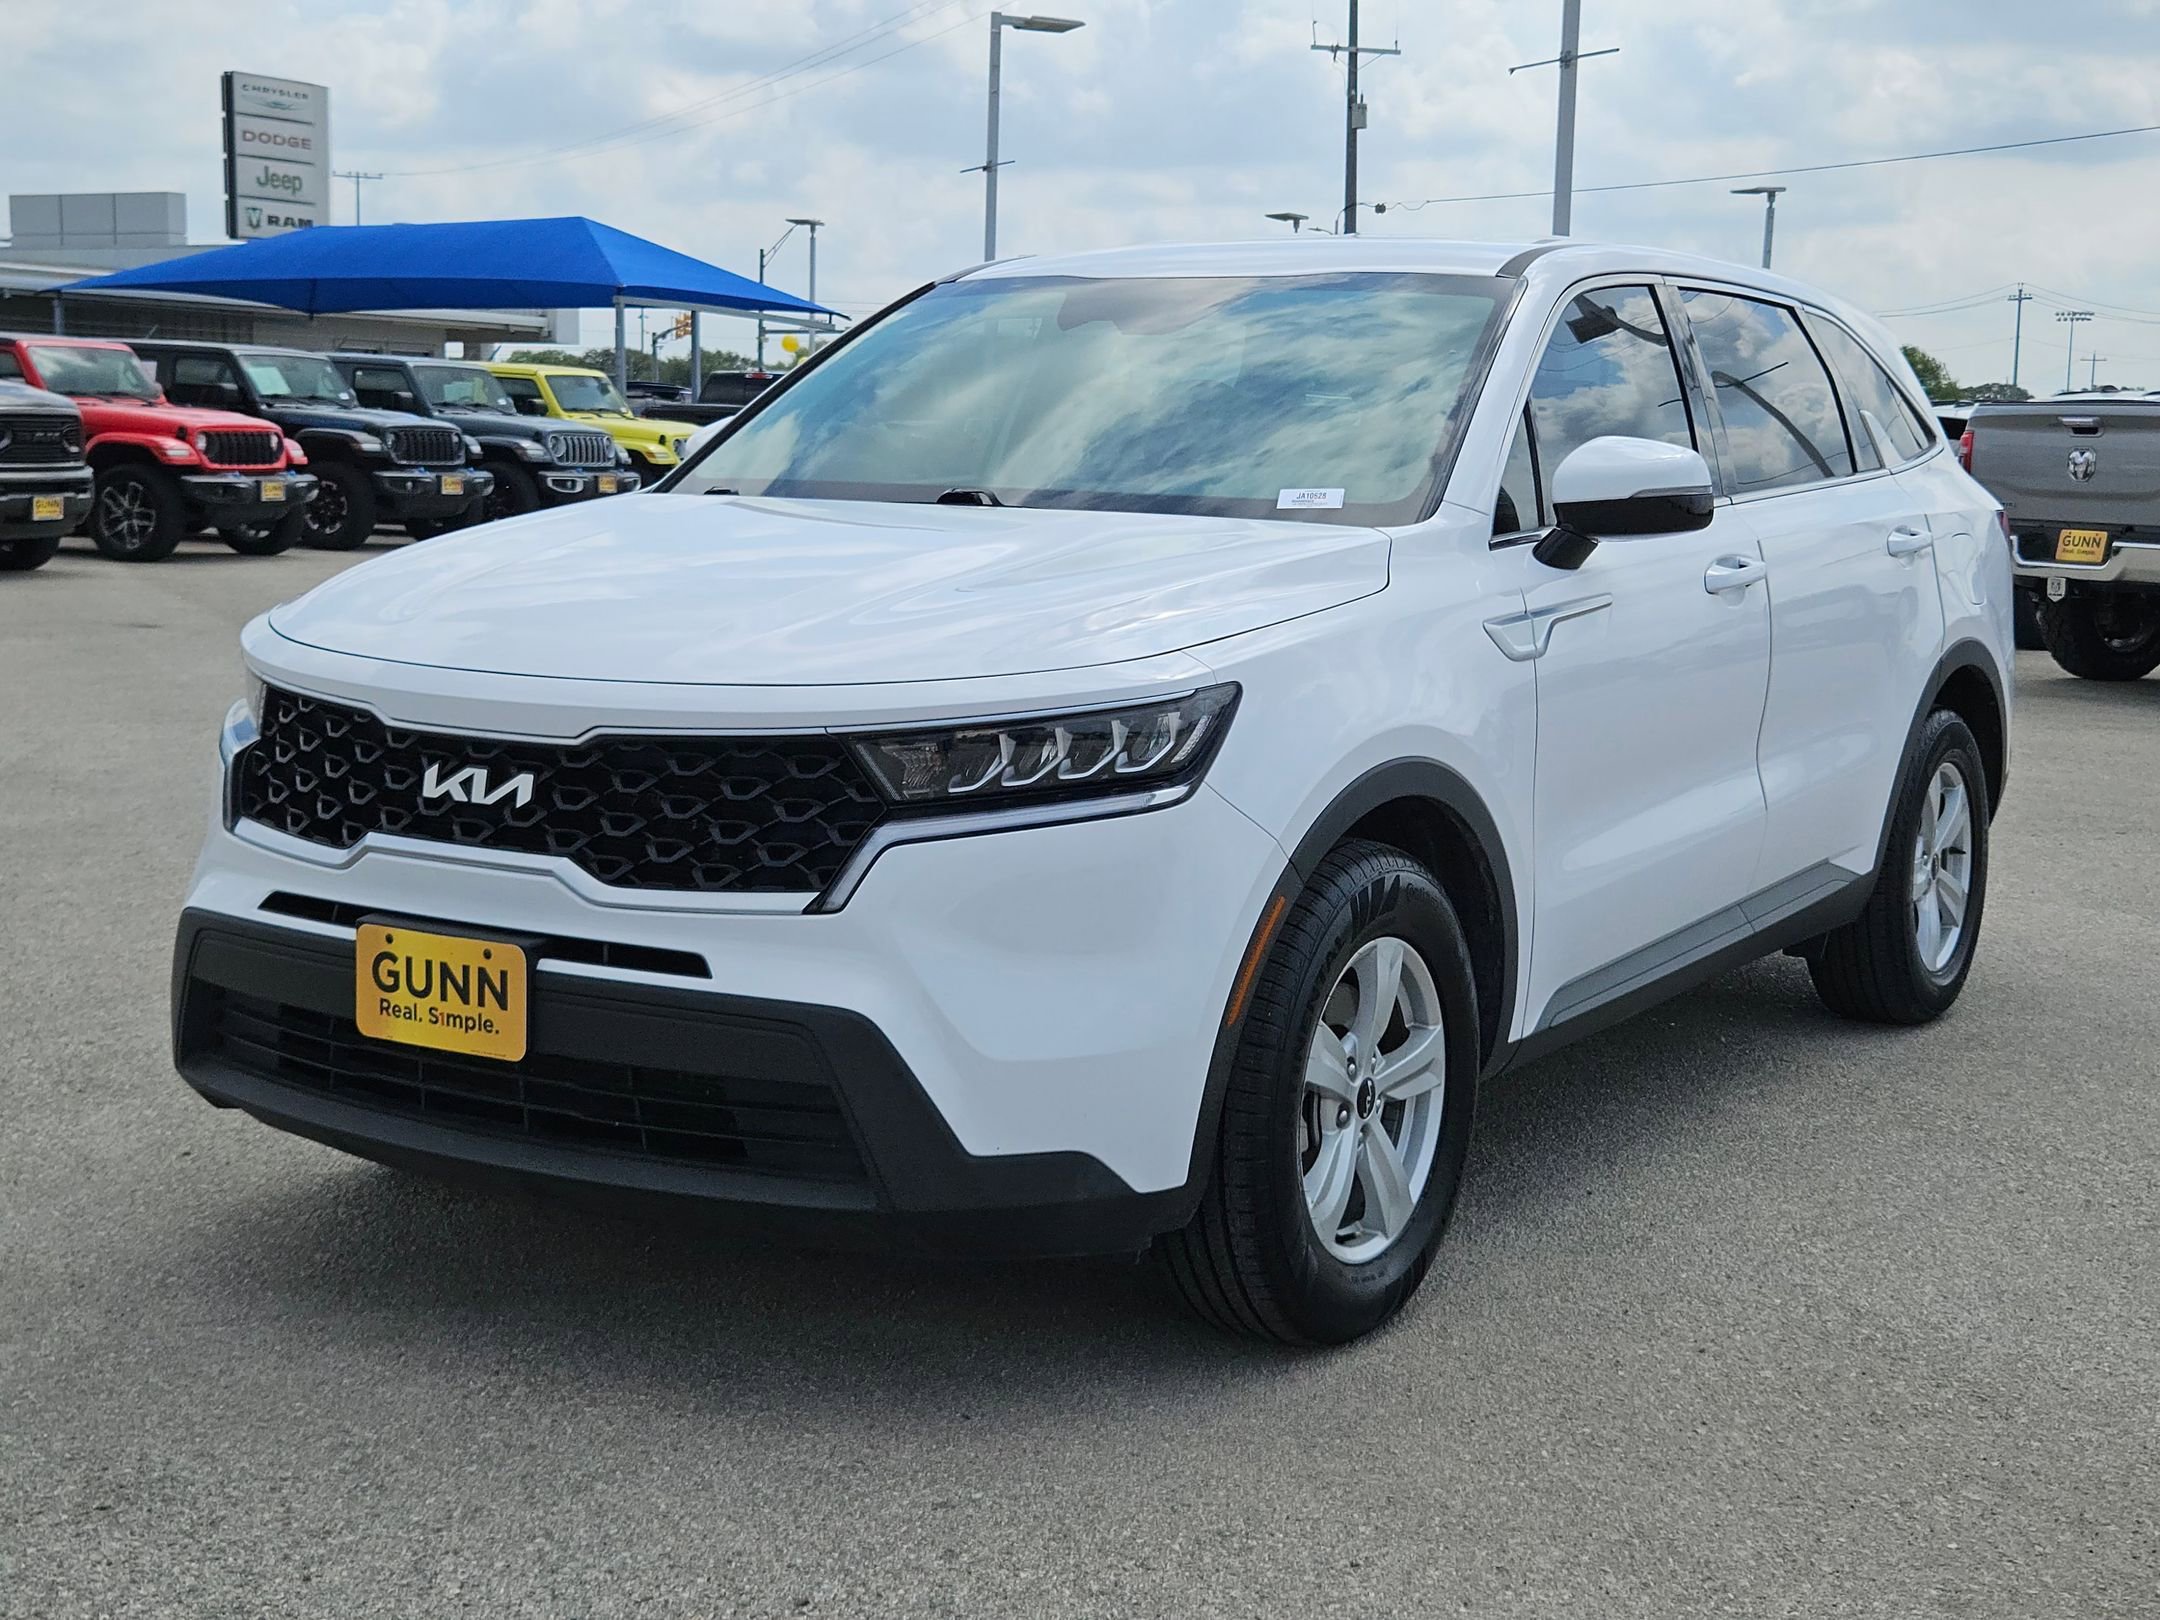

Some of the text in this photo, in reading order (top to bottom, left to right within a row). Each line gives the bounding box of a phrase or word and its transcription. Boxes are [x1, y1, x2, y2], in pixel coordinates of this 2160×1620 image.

[241, 83, 310, 100] CHRYSLER
[242, 129, 312, 150] DODGE
[256, 165, 303, 196] Jeep
[267, 214, 315, 229] RAM
[2062, 534, 2102, 549] GUNN
[422, 762, 535, 809] KIA
[371, 950, 509, 1012] GUNN
[379, 998, 423, 1023] Real.
